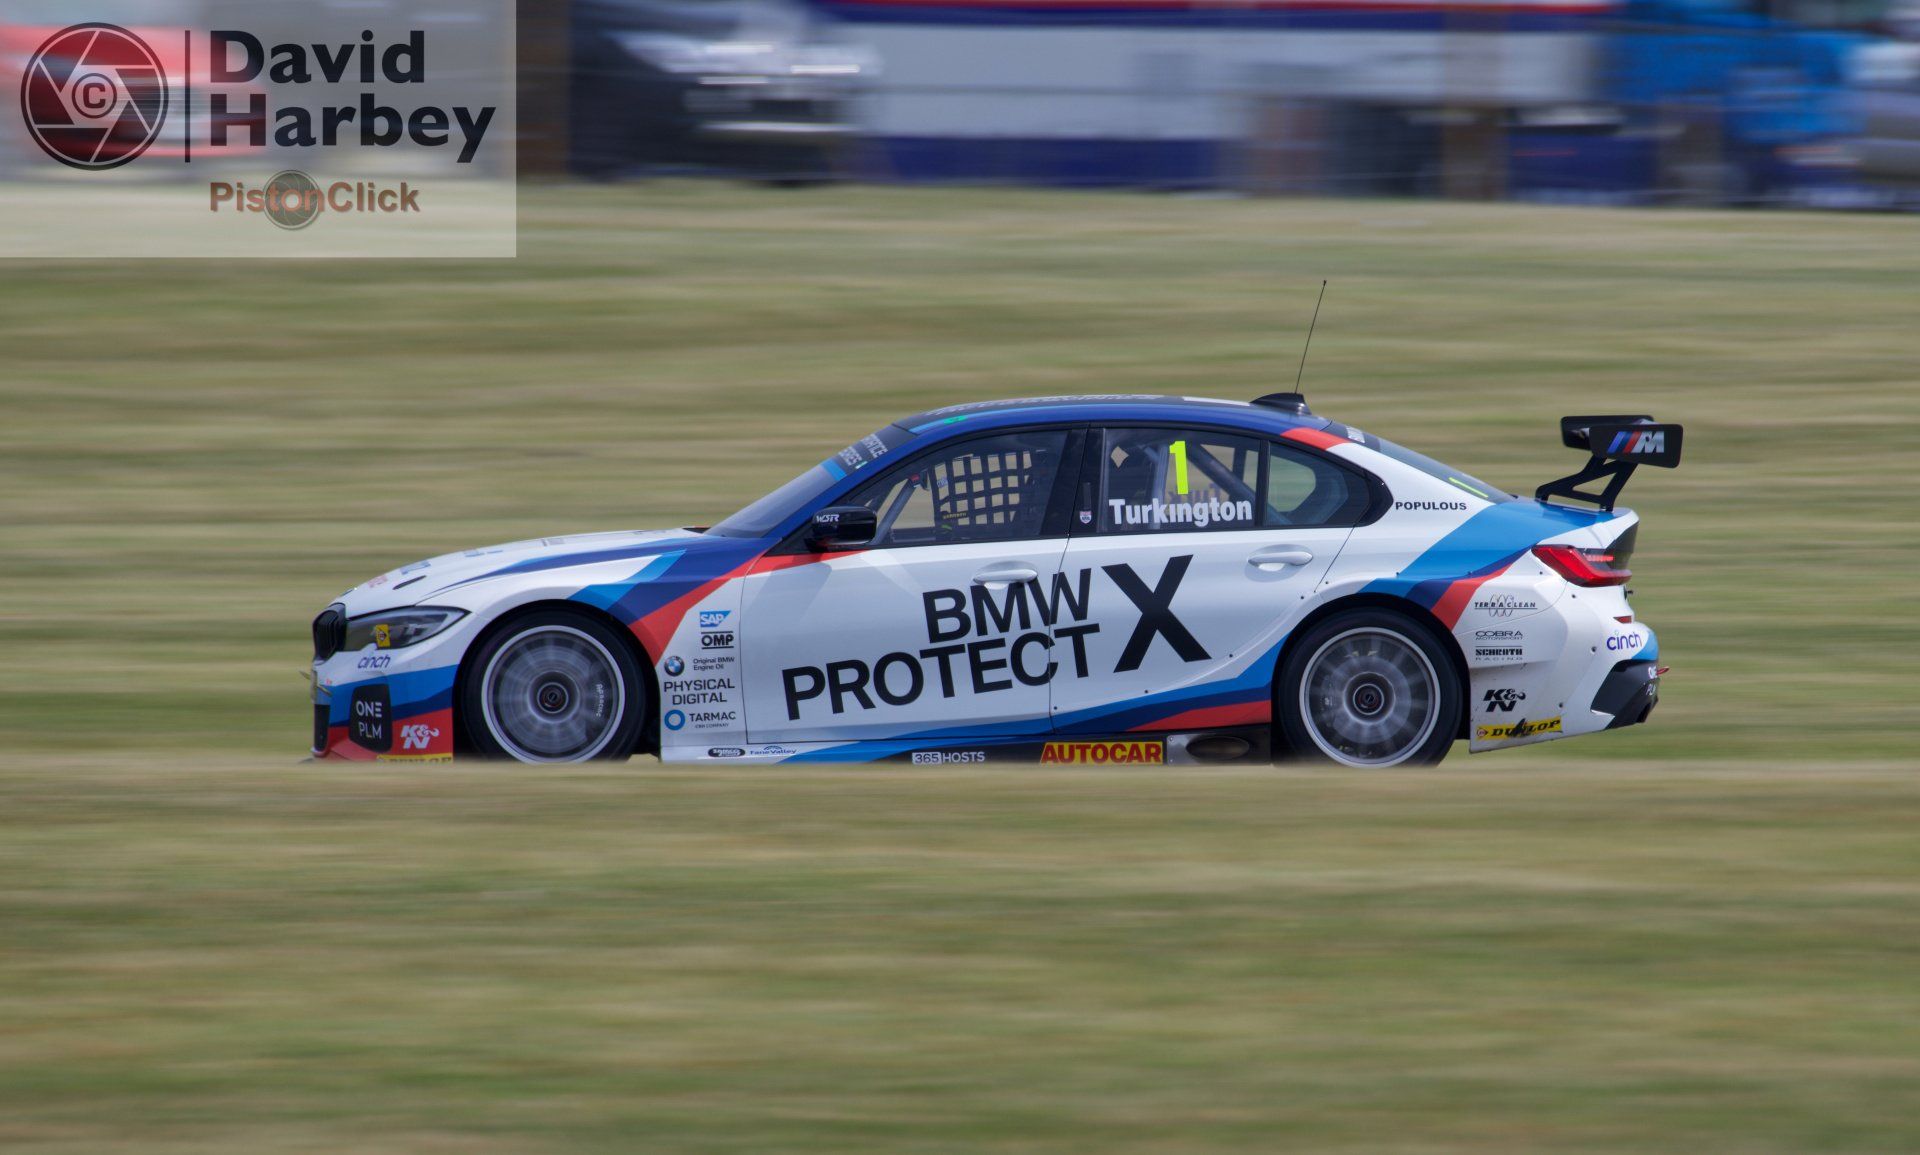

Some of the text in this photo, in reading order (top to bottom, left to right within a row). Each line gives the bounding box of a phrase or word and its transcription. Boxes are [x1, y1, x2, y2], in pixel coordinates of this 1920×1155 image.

[1169, 440, 1189, 495] 1
[1108, 497, 1253, 527] Turkington
[1395, 501, 1467, 511] POPULOUS
[816, 514, 840, 523] WSR
[922, 567, 1093, 644] BMW
[1101, 554, 1212, 674] X
[700, 612, 725, 625] SAP
[701, 633, 735, 647] OMP
[1606, 631, 1643, 651] cinch
[1475, 648, 1523, 656] SCHROTH
[357, 654, 391, 669] cinch
[693, 657, 717, 666] Original
[781, 623, 1101, 721] PROTECT
[663, 677, 736, 693] PHYSICAL
[672, 691, 728, 706] DIGITAL
[1483, 688, 1527, 713] K&N
[355, 700, 383, 718] ONE
[689, 711, 736, 722] TARMAC
[358, 721, 382, 740] PLM
[400, 723, 440, 750] K&N
[1491, 719, 1560, 737] DULOP
[1040, 743, 1163, 764] AUTOCAR
